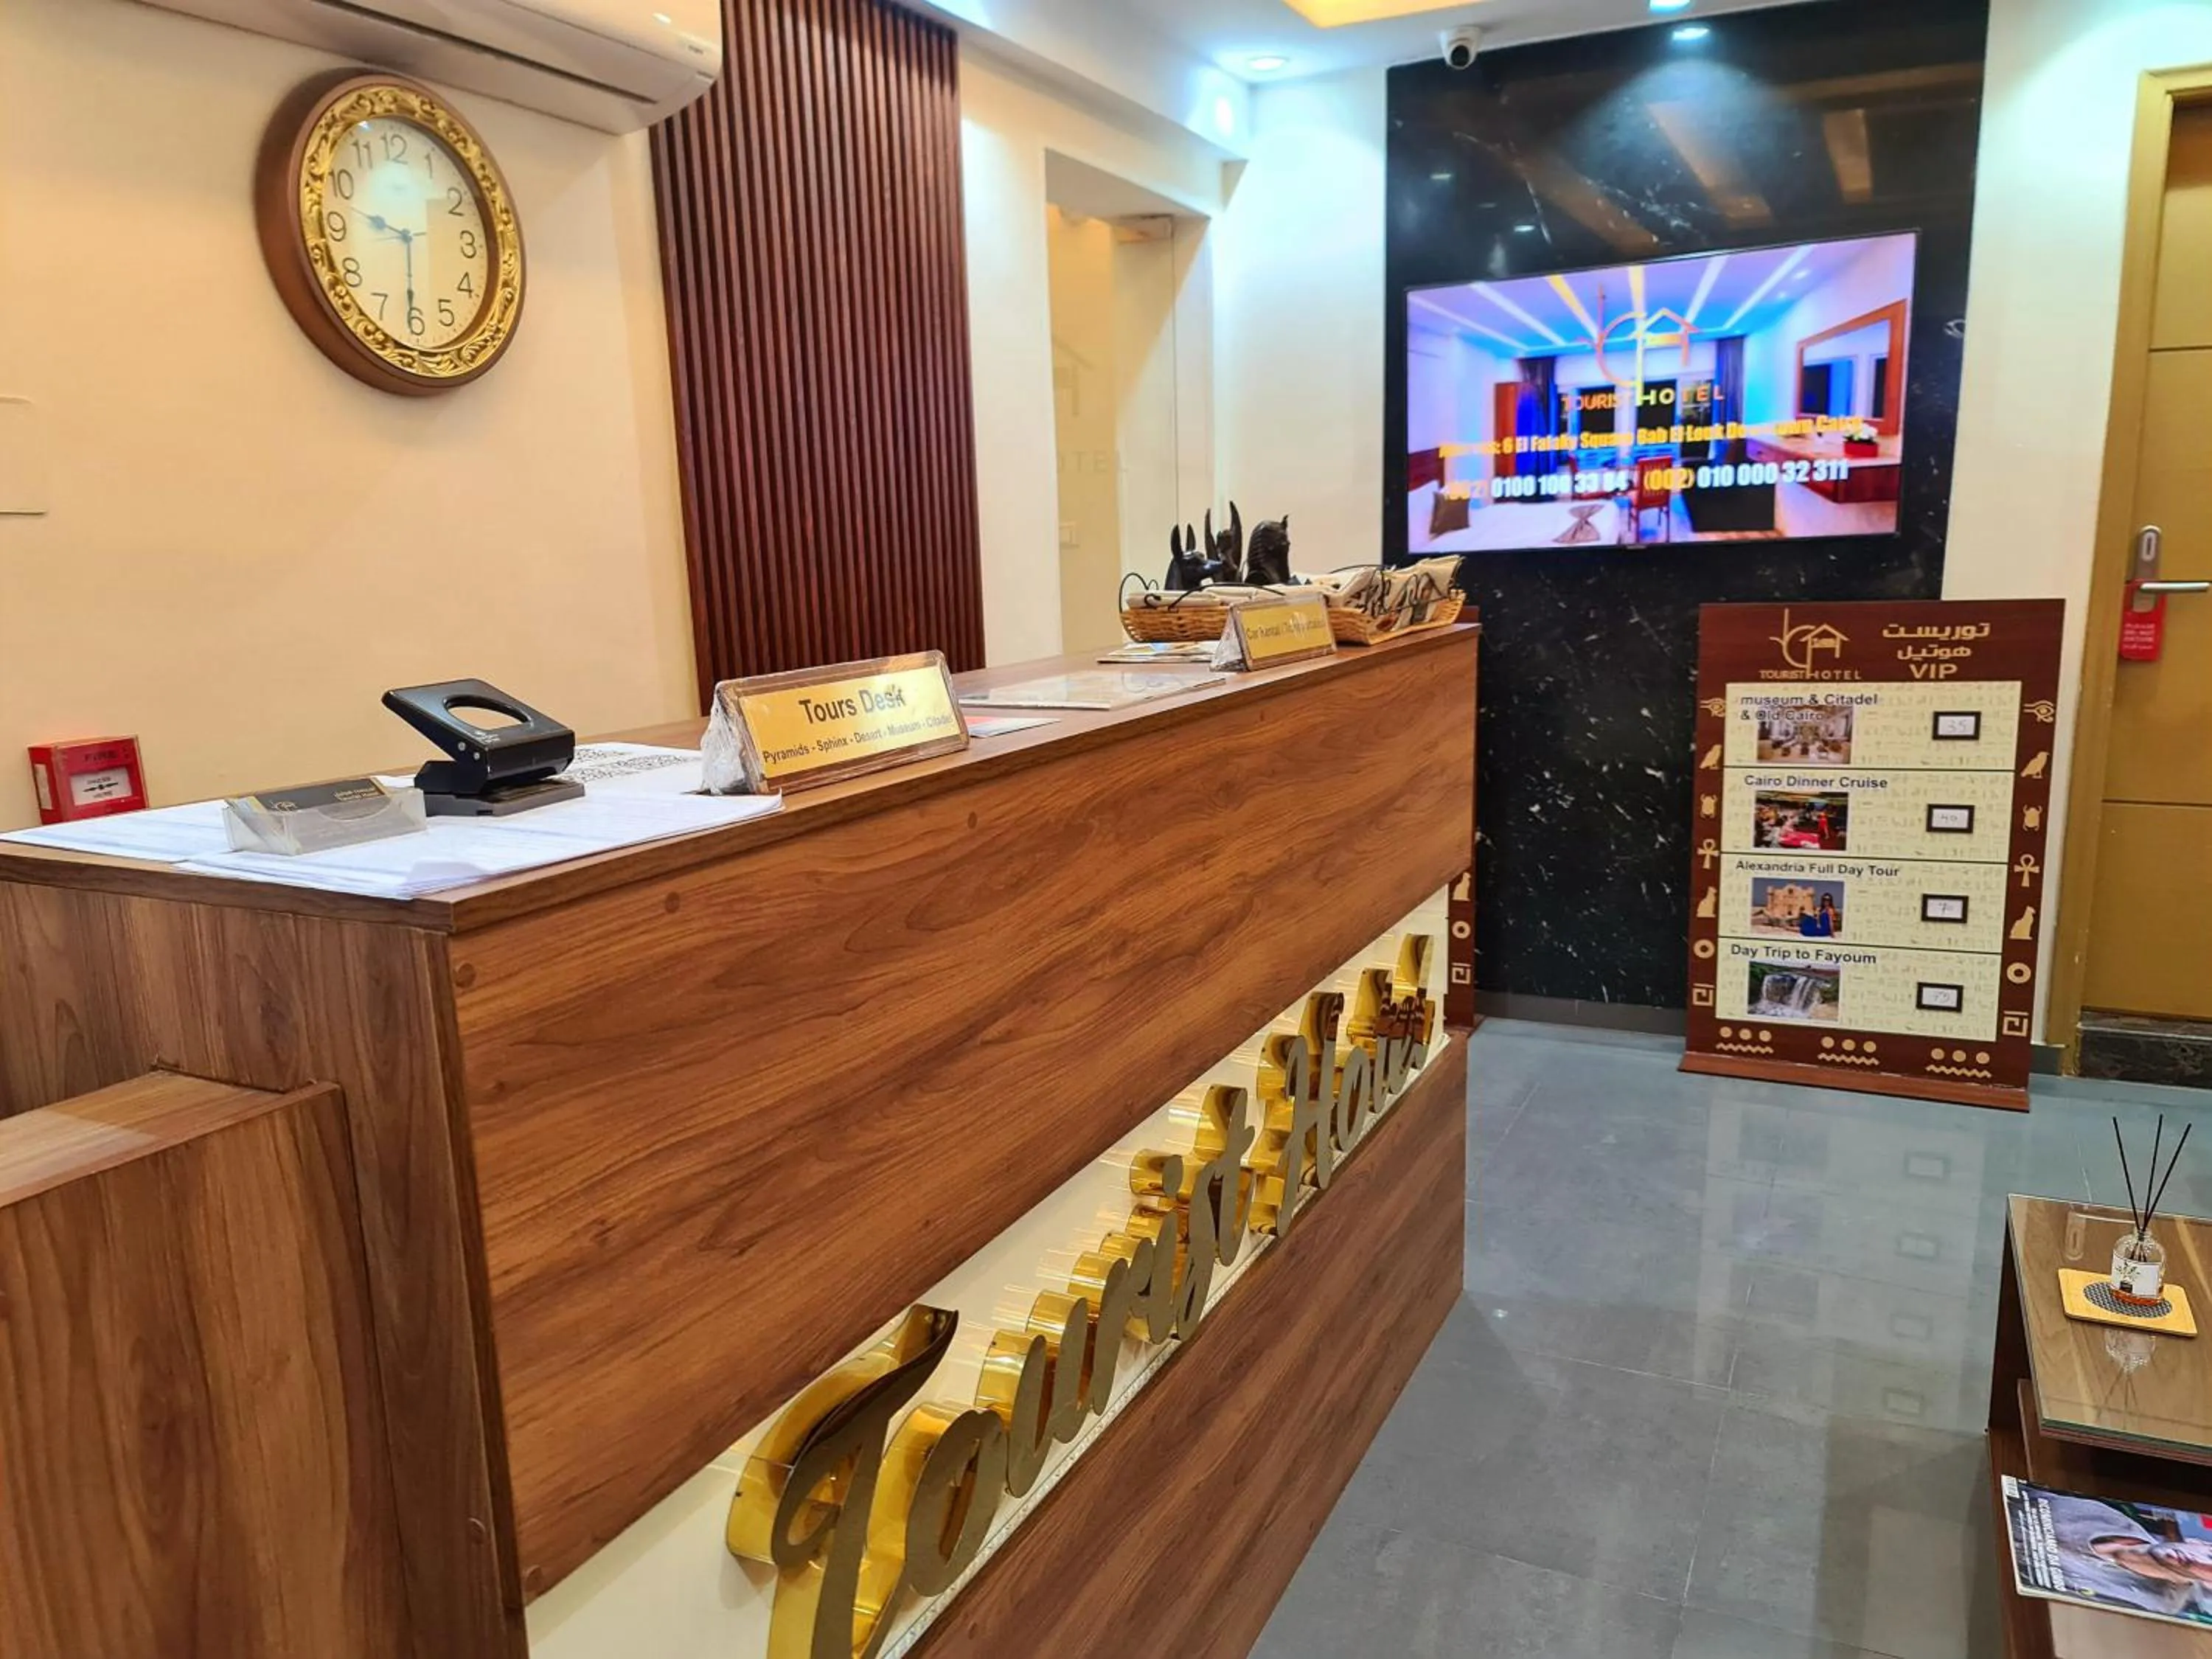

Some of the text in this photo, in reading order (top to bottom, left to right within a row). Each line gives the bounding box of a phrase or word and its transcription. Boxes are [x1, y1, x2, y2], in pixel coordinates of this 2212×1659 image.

[352, 139, 373, 170] 11
[382, 133, 409, 164] 12
[424, 153, 434, 178] 1
[330, 169, 354, 200] 10
[447, 187, 465, 217] 2
[327, 212, 347, 242] 9
[459, 230, 477, 259] 3
[342, 257, 363, 288] 8
[457, 272, 473, 298] 4
[371, 293, 389, 321] 7
[408, 306, 425, 336] 6
[438, 299, 455, 327] 5
[1491, 474, 1537, 498] 0100
[1644, 467, 1695, 491] (002)
[1697, 464, 1735, 488] 010
[1736, 461, 1778, 486] 000
[1781, 459, 1810, 484] 32
[1812, 459, 1848, 481] 311
[1882, 622, 1991, 641] توريست
[1897, 644, 1972, 661] هوتيل
[1759, 669, 1863, 680] TOURIST HOTEL
[1909, 664, 1958, 680] VIP
[799, 684, 906, 724] Tours Desk
[1741, 693, 1879, 706] museum & Citadel
[1741, 710, 1824, 721] & Old Cairo
[762, 744, 810, 765] Pyramids
[816, 736, 849, 754] Sphinx
[854, 728, 883, 744] Desert
[888, 723, 921, 737] Museum
[1745, 775, 1888, 788] Cairo Dinner Cruise
[1735, 860, 1900, 877] Alexandria Full Day Tour
[1731, 943, 1877, 964] Day Trip to Fayoum
[737, 1084, 1255, 1659] Tourist
